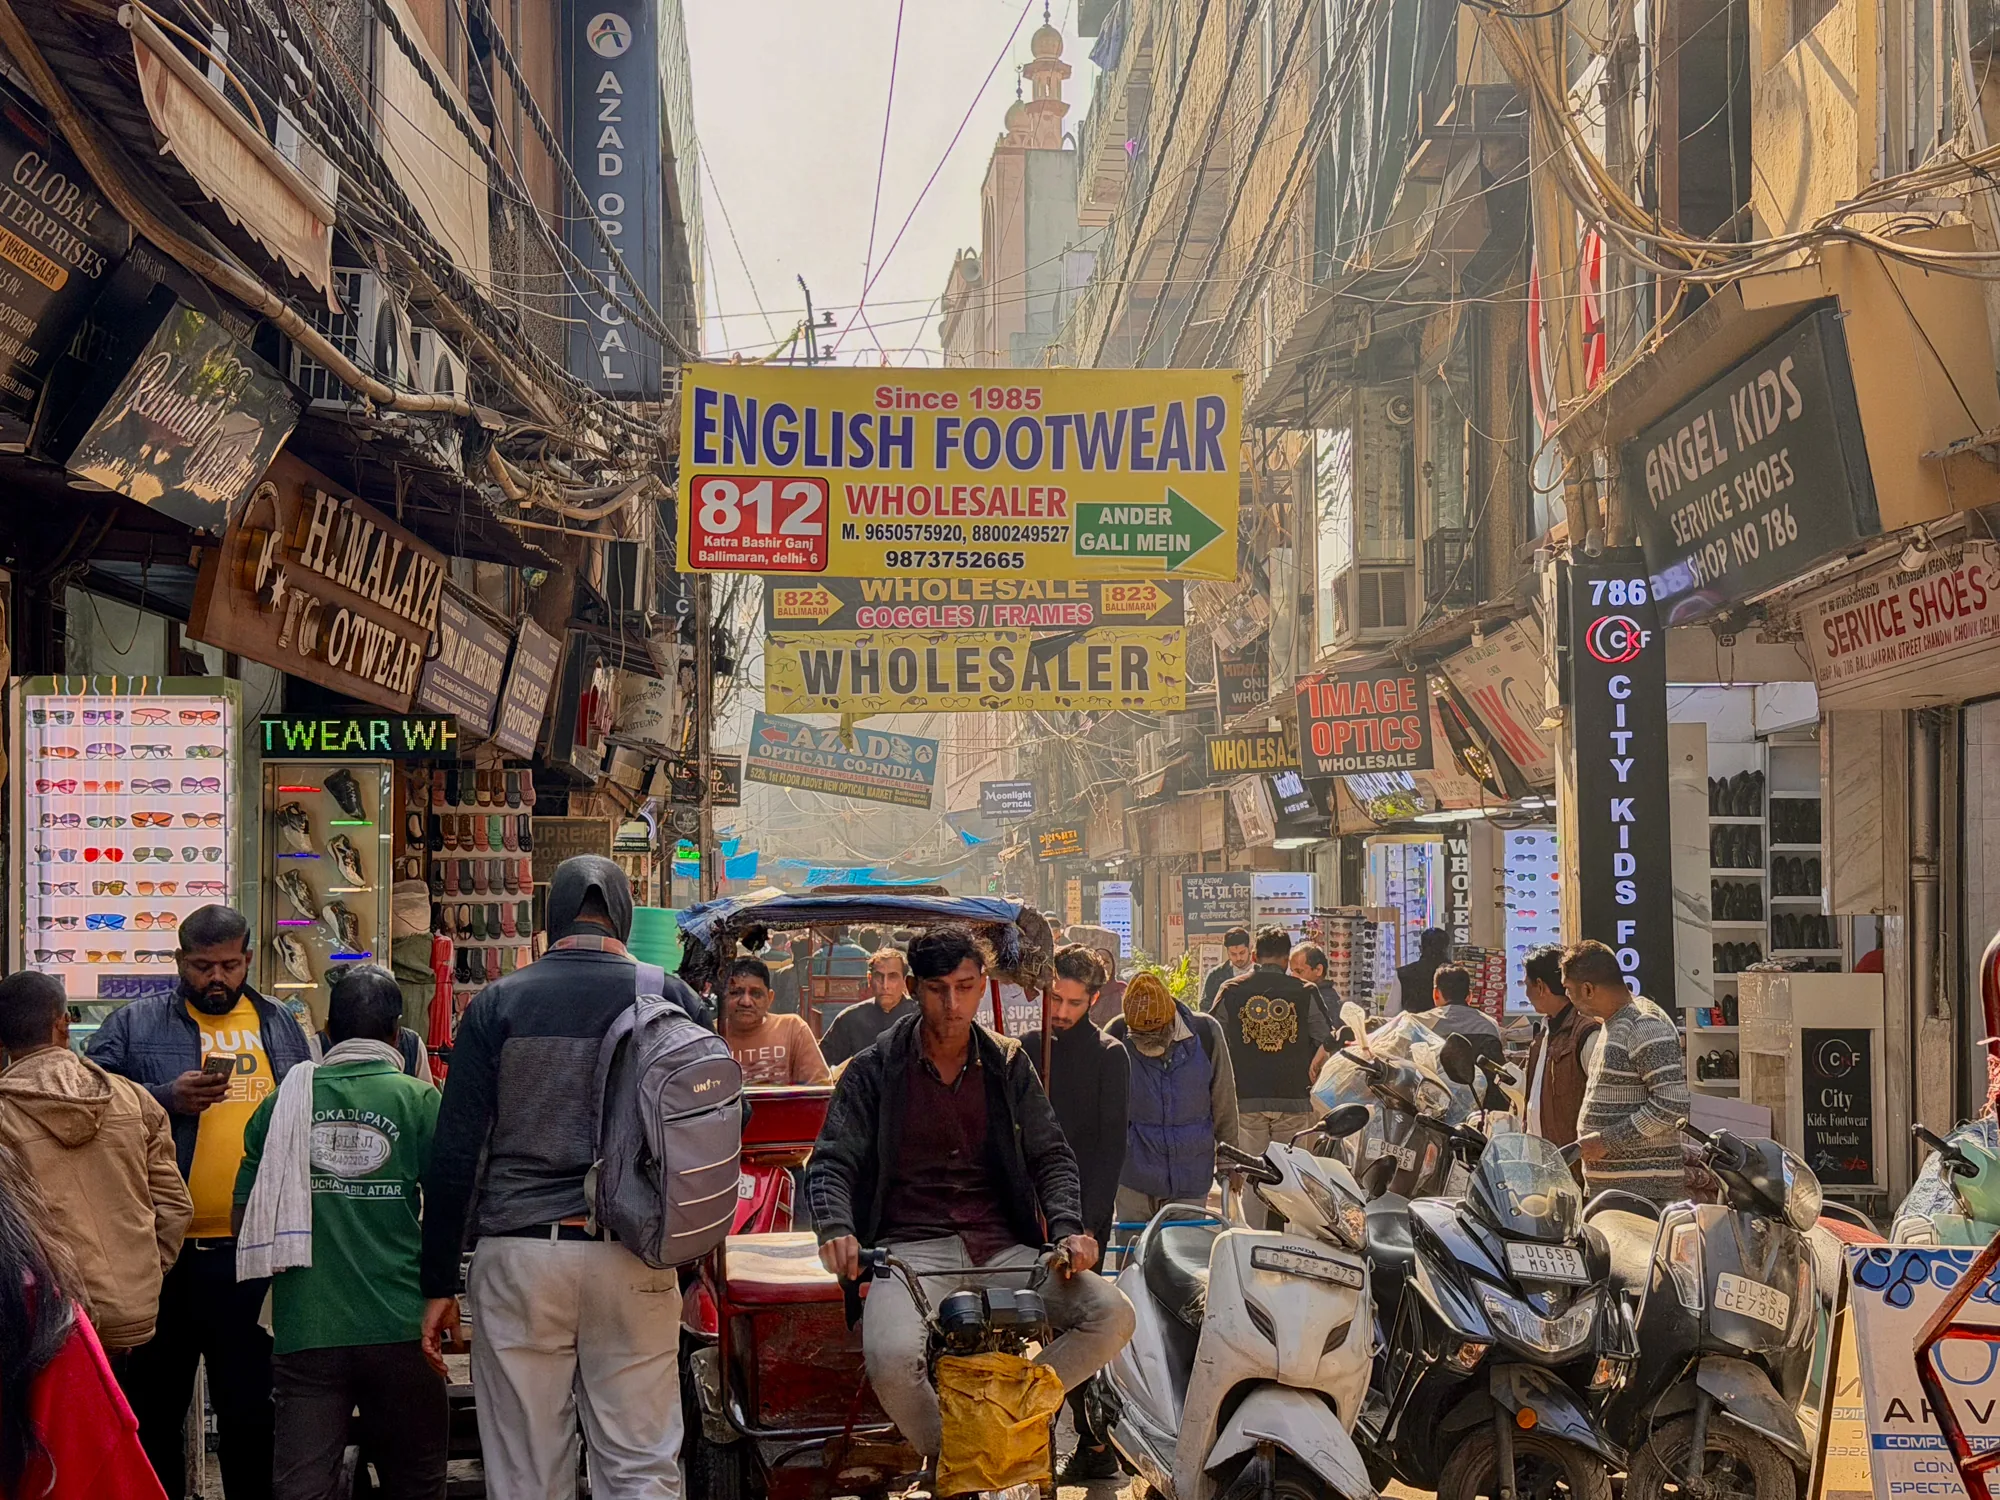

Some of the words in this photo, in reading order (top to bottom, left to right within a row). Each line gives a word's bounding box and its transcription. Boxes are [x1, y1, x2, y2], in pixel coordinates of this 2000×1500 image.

[595, 70, 625, 177] AZAD
[13, 151, 102, 237] GLOBAL
[2, 234, 59, 286] WHOLESALER
[875, 386, 959, 409] Since
[969, 387, 1042, 410] 1985
[693, 386, 914, 469] ENGLISH
[935, 395, 1226, 472] FOOTWEAR
[1645, 408, 1729, 511] ANGEL
[1730, 355, 1803, 453] KIDS
[698, 480, 823, 536] 812
[845, 484, 1066, 517] WHOLESALER
[1670, 483, 1734, 547] SERVICE
[1734, 447, 1795, 512] SHOES
[1099, 507, 1172, 526] ANDER
[703, 536, 738, 547] Katra
[742, 536, 782, 549] Bashir
[785, 538, 813, 551] Ganj
[842, 523, 860, 541] M.
[865, 524, 967, 545] 9650575920,
[972, 525, 1070, 544] 8800249527
[1079, 533, 1129, 551] GALI
[1137, 533, 1191, 552] MEIN
[1687, 537, 1728, 589] SHOP
[1731, 522, 1760, 567] NO
[1761, 503, 1798, 551] 786
[300, 487, 445, 633] HIMALAYA
[698, 550, 769, 565] Ballimaran,
[810, 552, 818, 565] 6
[885, 550, 1025, 570] 9873752665
[784, 591, 829, 606] 823
[859, 578, 1090, 602] WHOLESALE
[1112, 586, 1157, 602] 823
[1588, 579, 1647, 606] 786
[777, 607, 829, 616] BALLIMARAN
[856, 604, 974, 629] GOGGLES
[993, 603, 1094, 627] FRAMES
[1105, 602, 1157, 612] BALLIMARAN
[1823, 594, 1907, 658] SERVICE
[1908, 565, 1988, 630] SHOES
[1609, 630, 1652, 649] CKF
[799, 646, 1151, 696] WHOLESALER
[1297, 675, 1315, 691] NEW
[1308, 677, 1419, 719] IMAGE
[259, 720, 392, 751] TWEAR
[1310, 715, 1422, 757] OPTICS
[1608, 674, 1635, 784] CITY
[791, 727, 891, 760] AZAD
[1210, 736, 1301, 771] WHOLESAL
[758, 743, 836, 769] OPTICAL
[843, 758, 925, 782] CO-INDIA
[1318, 752, 1417, 773] WHOLESALE
[779, 773, 801, 786] FLOOR
[801, 776, 823, 789] ABOVE
[824, 780, 838, 792] NEW
[839, 783, 866, 797] OPTICAL
[867, 787, 893, 801] MARKET
[984, 790, 1032, 802] Moonlight
[1001, 800, 1032, 809] OPTICAL
[1610, 797, 1638, 906] KIDS
[1820, 1088, 1853, 1112] City
[1807, 1113, 1827, 1127] Kids
[1829, 1113, 1869, 1127] Footwear
[1816, 1131, 1860, 1146] Wholesale
[367, 1184, 402, 1196] ATTAR
[1281, 1245, 1318, 1257] HONDA
[1525, 1245, 1573, 1262] DL6SB
